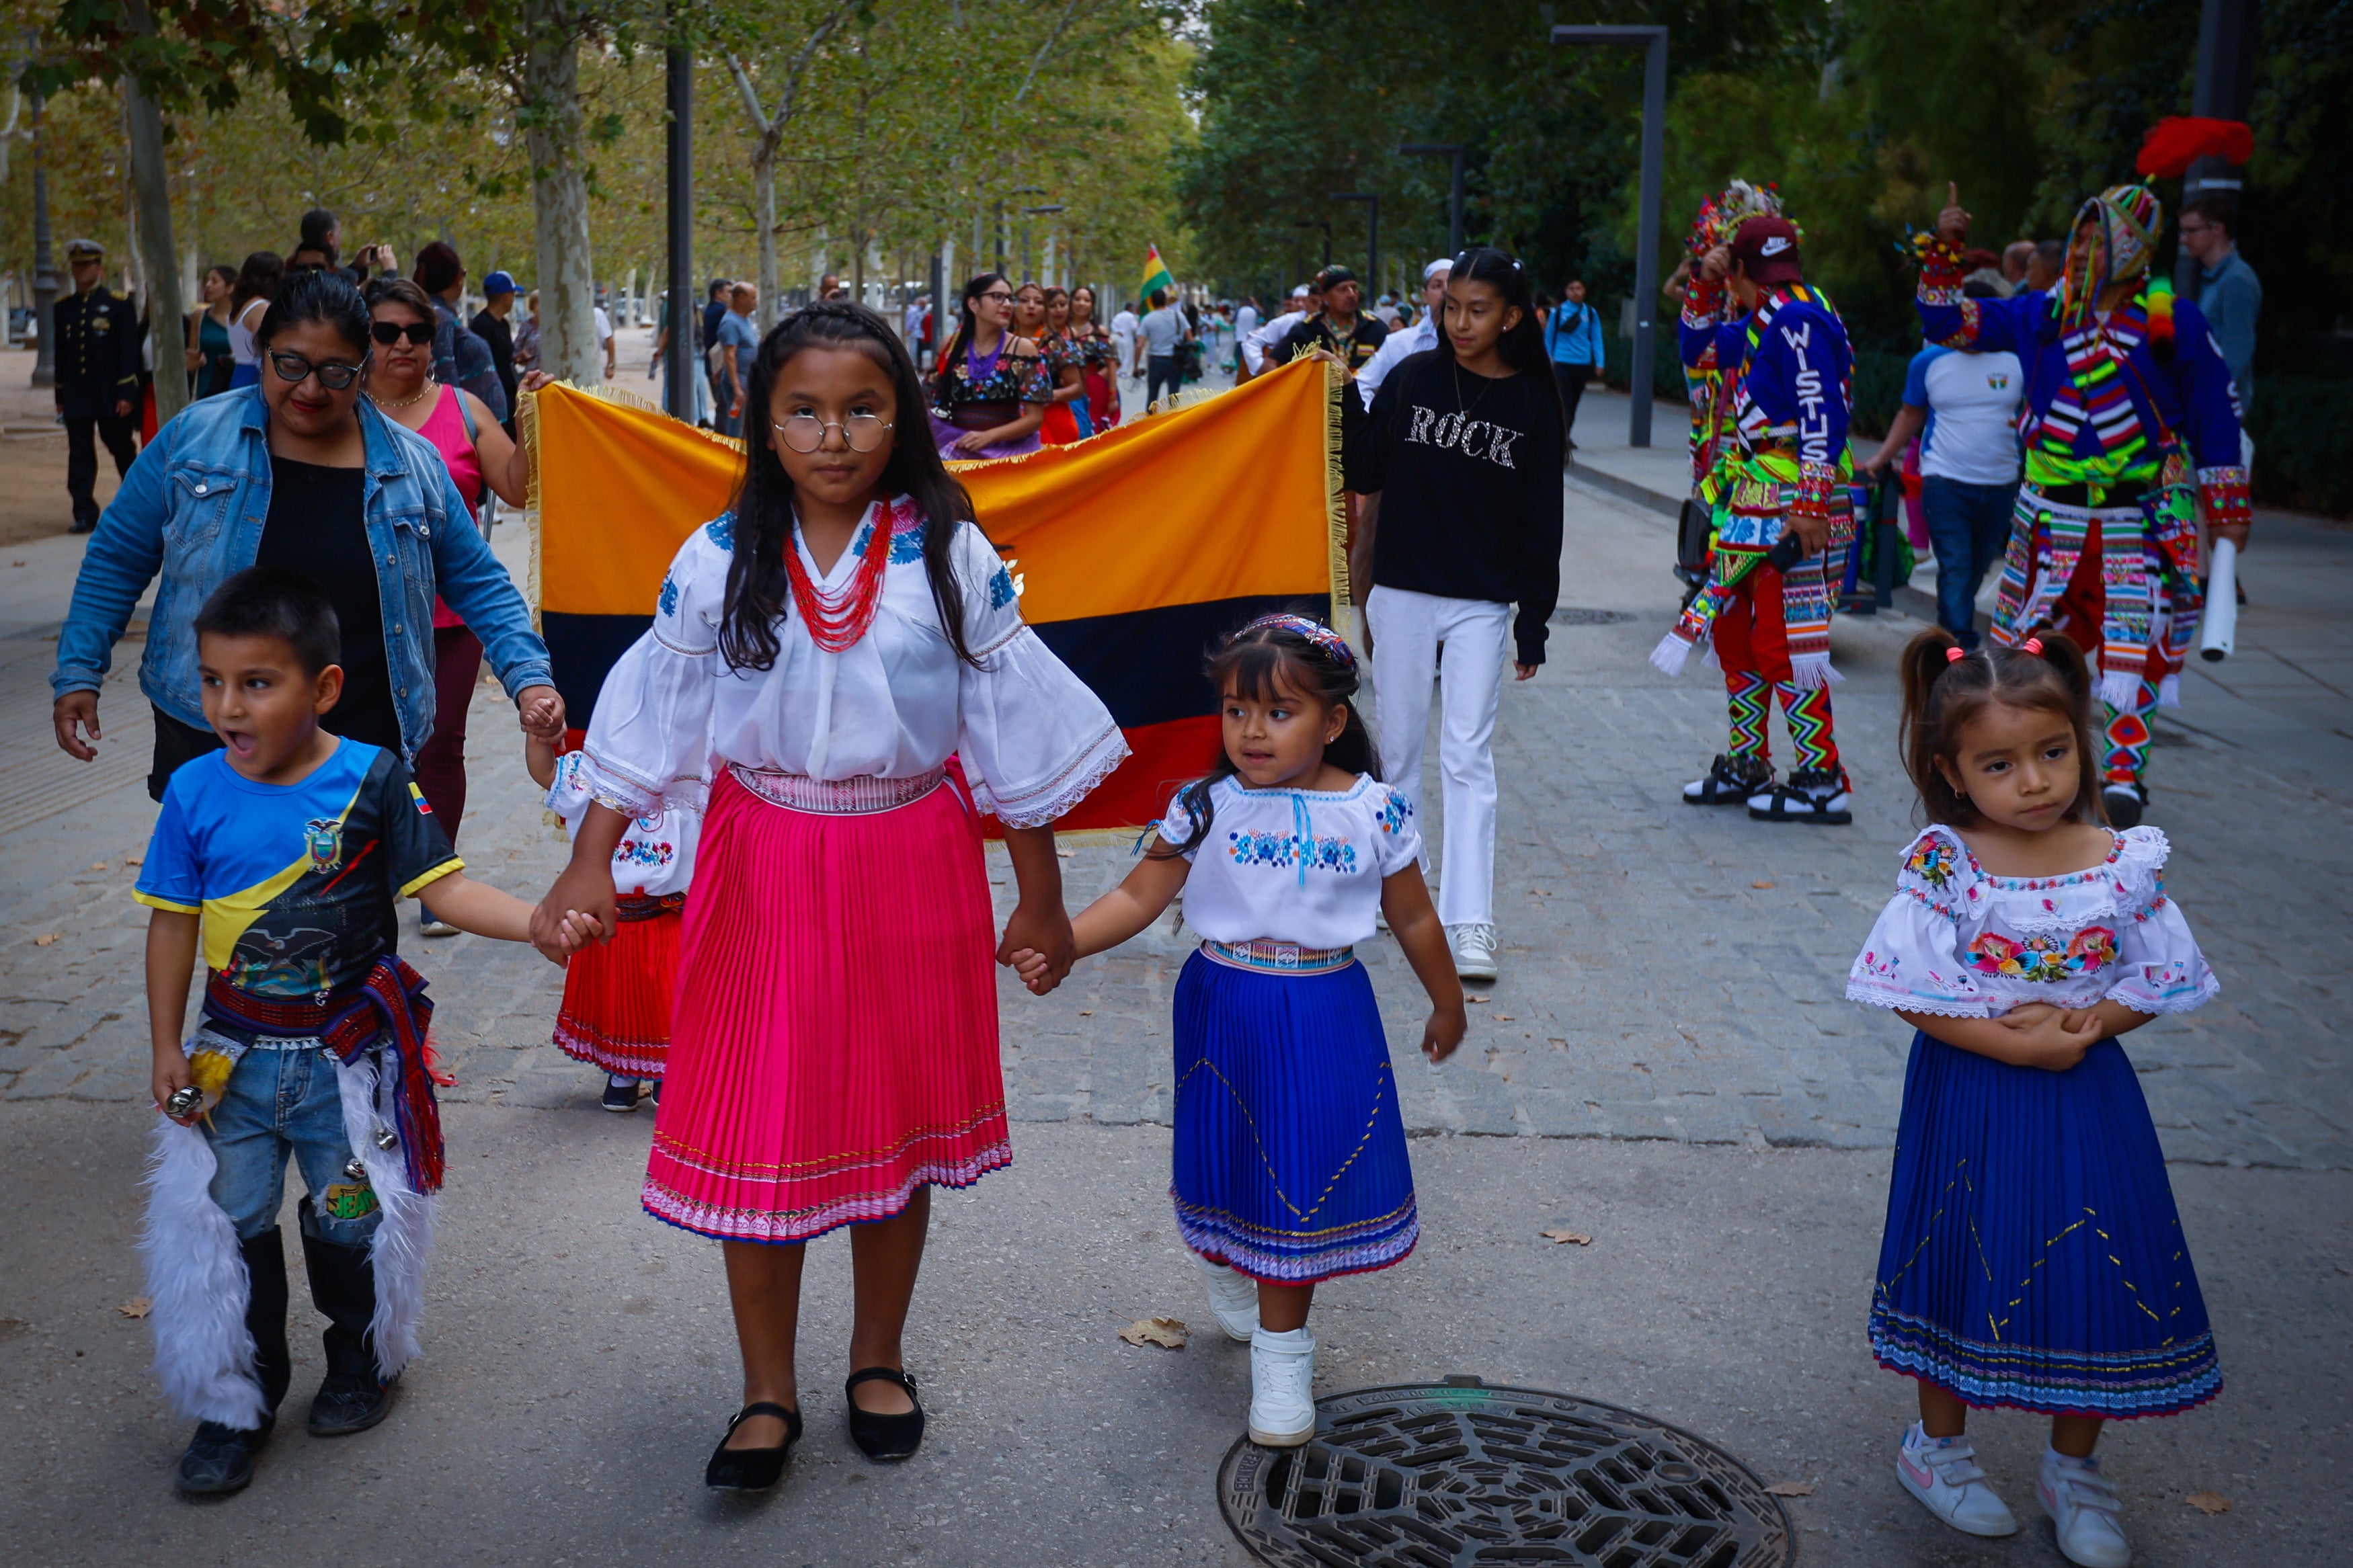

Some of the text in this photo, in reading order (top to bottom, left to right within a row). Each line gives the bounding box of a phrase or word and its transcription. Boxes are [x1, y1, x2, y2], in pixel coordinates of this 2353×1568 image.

[1780, 321, 1829, 462] WISTUS
[1404, 405, 1524, 468] ROCK
[1236, 1453, 1261, 1490] FRANCE
